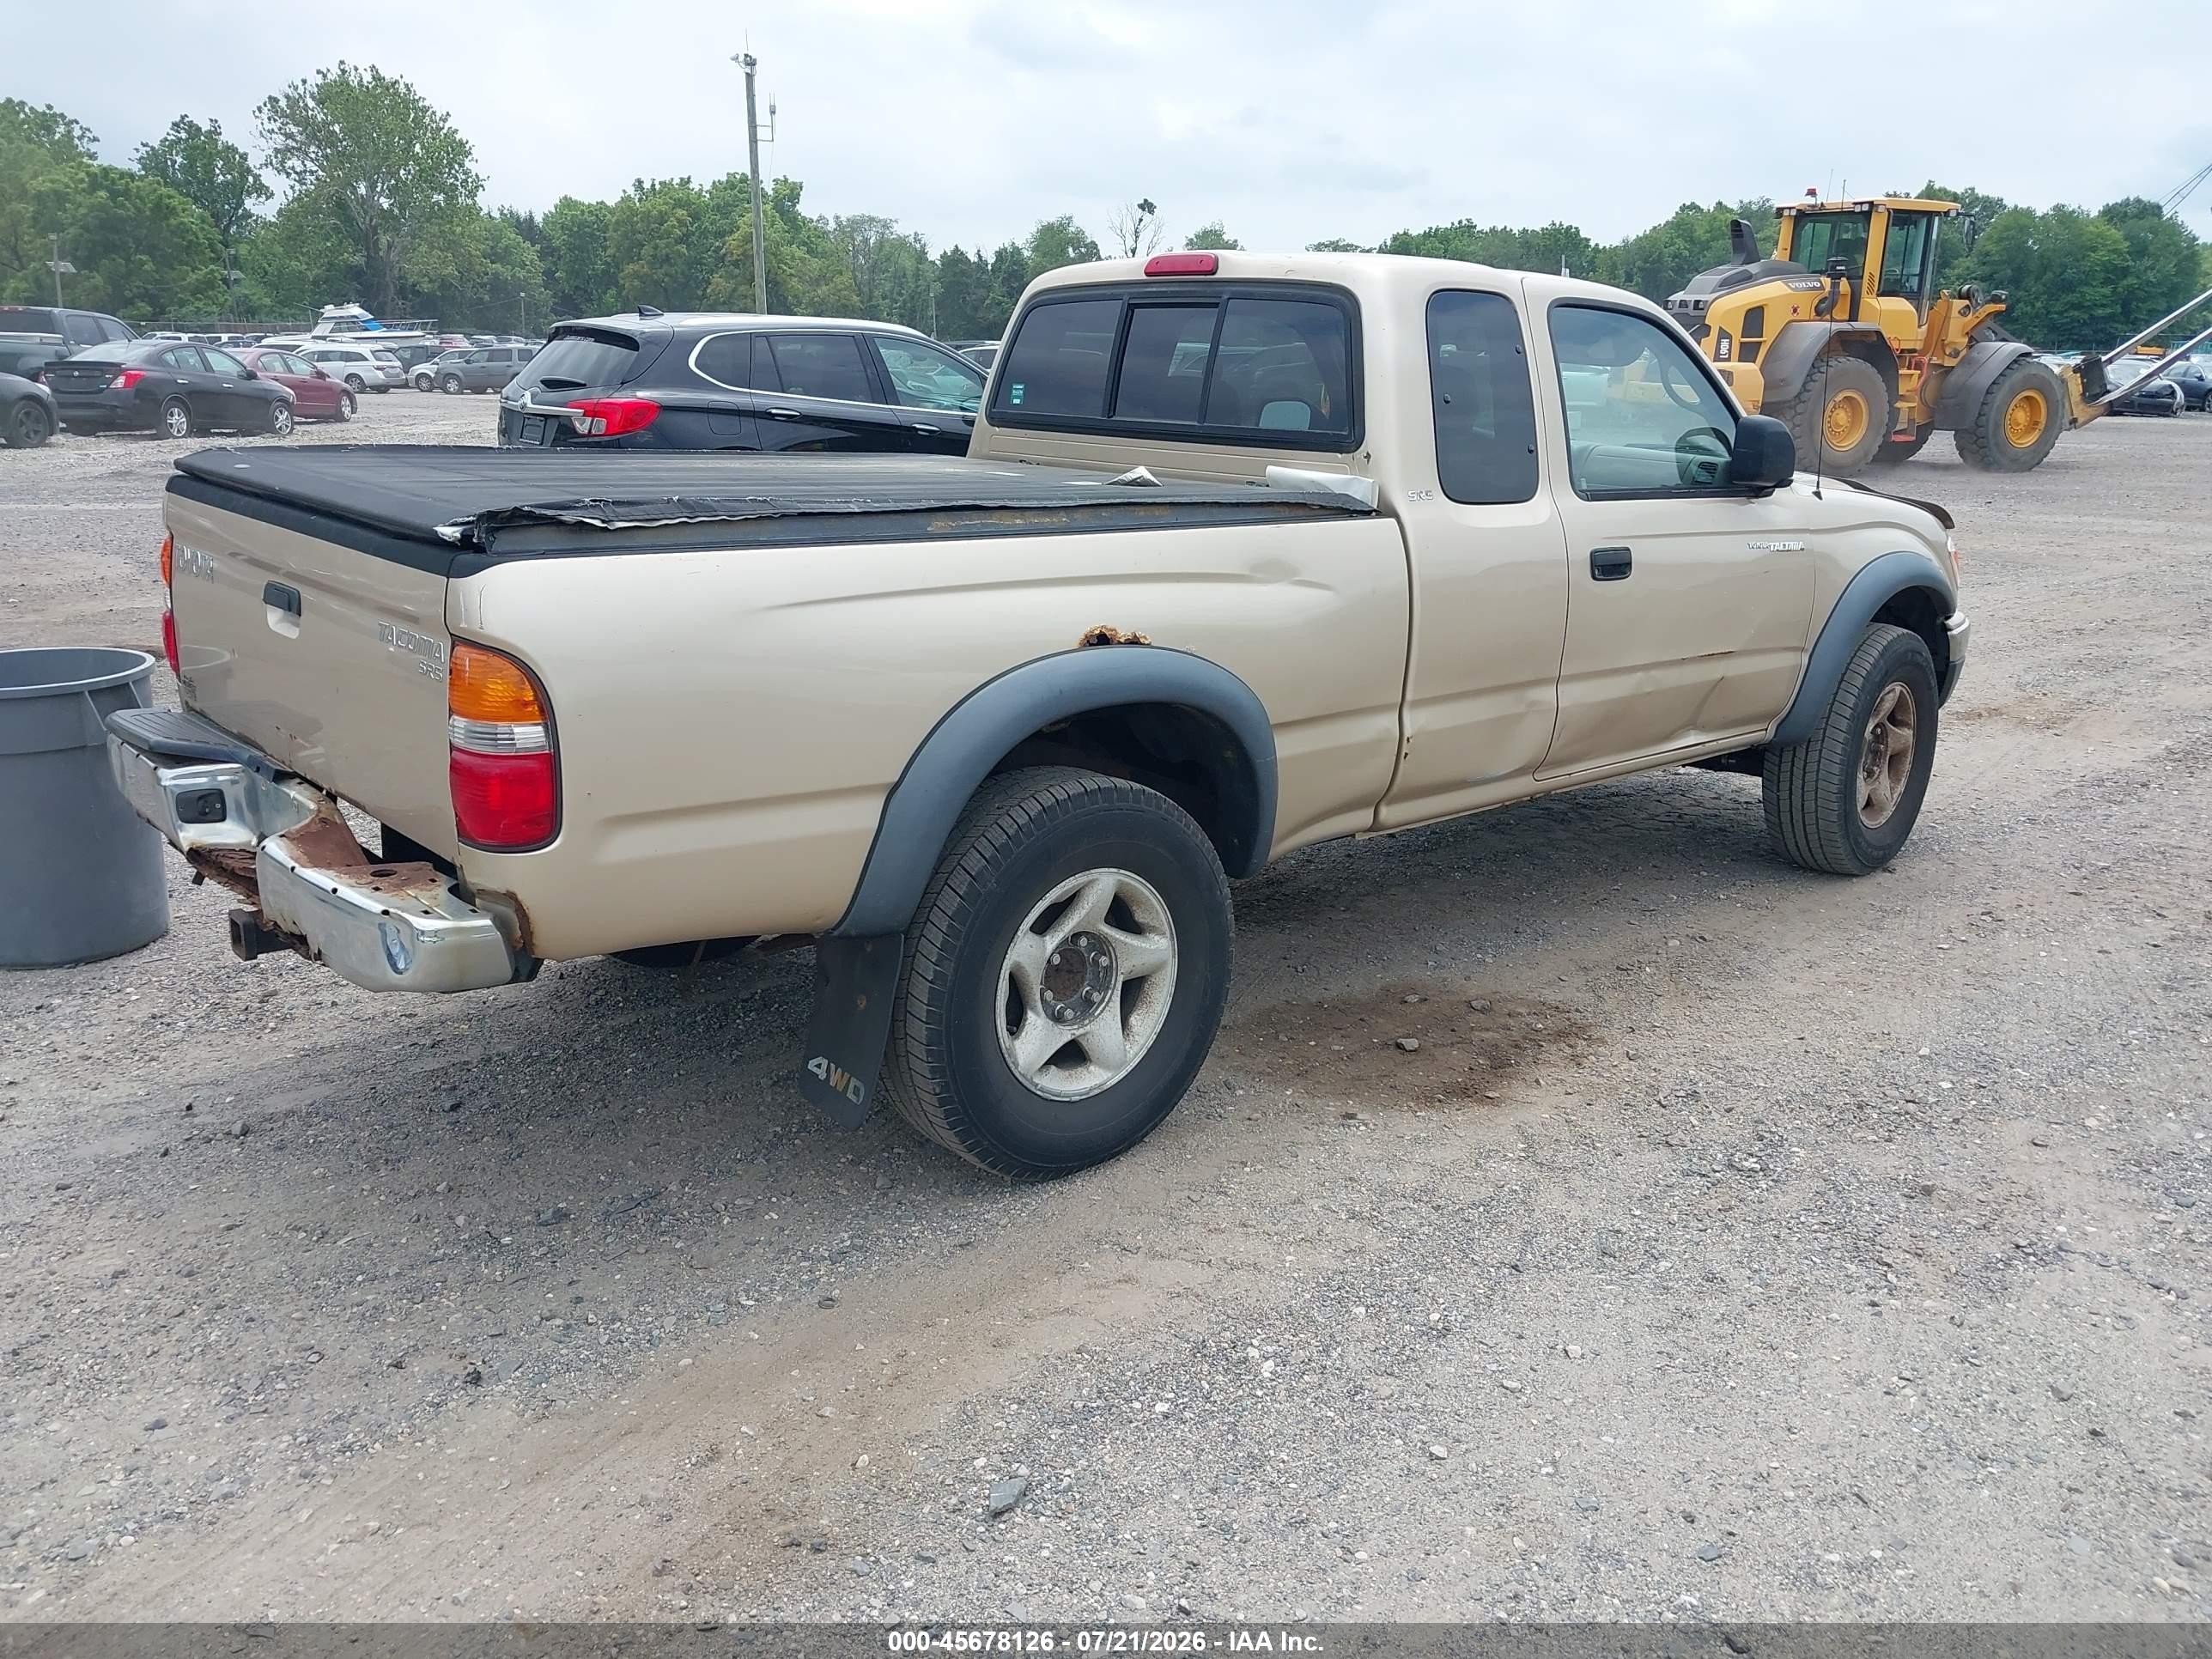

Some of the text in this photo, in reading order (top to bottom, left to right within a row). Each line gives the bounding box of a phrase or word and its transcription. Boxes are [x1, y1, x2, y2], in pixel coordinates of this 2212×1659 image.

[1719, 338, 1730, 358] L90H
[174, 543, 214, 582] TOYOTA
[378, 619, 445, 663] TACOMA
[418, 659, 443, 682] SR5
[807, 1056, 865, 1105] 4WD
